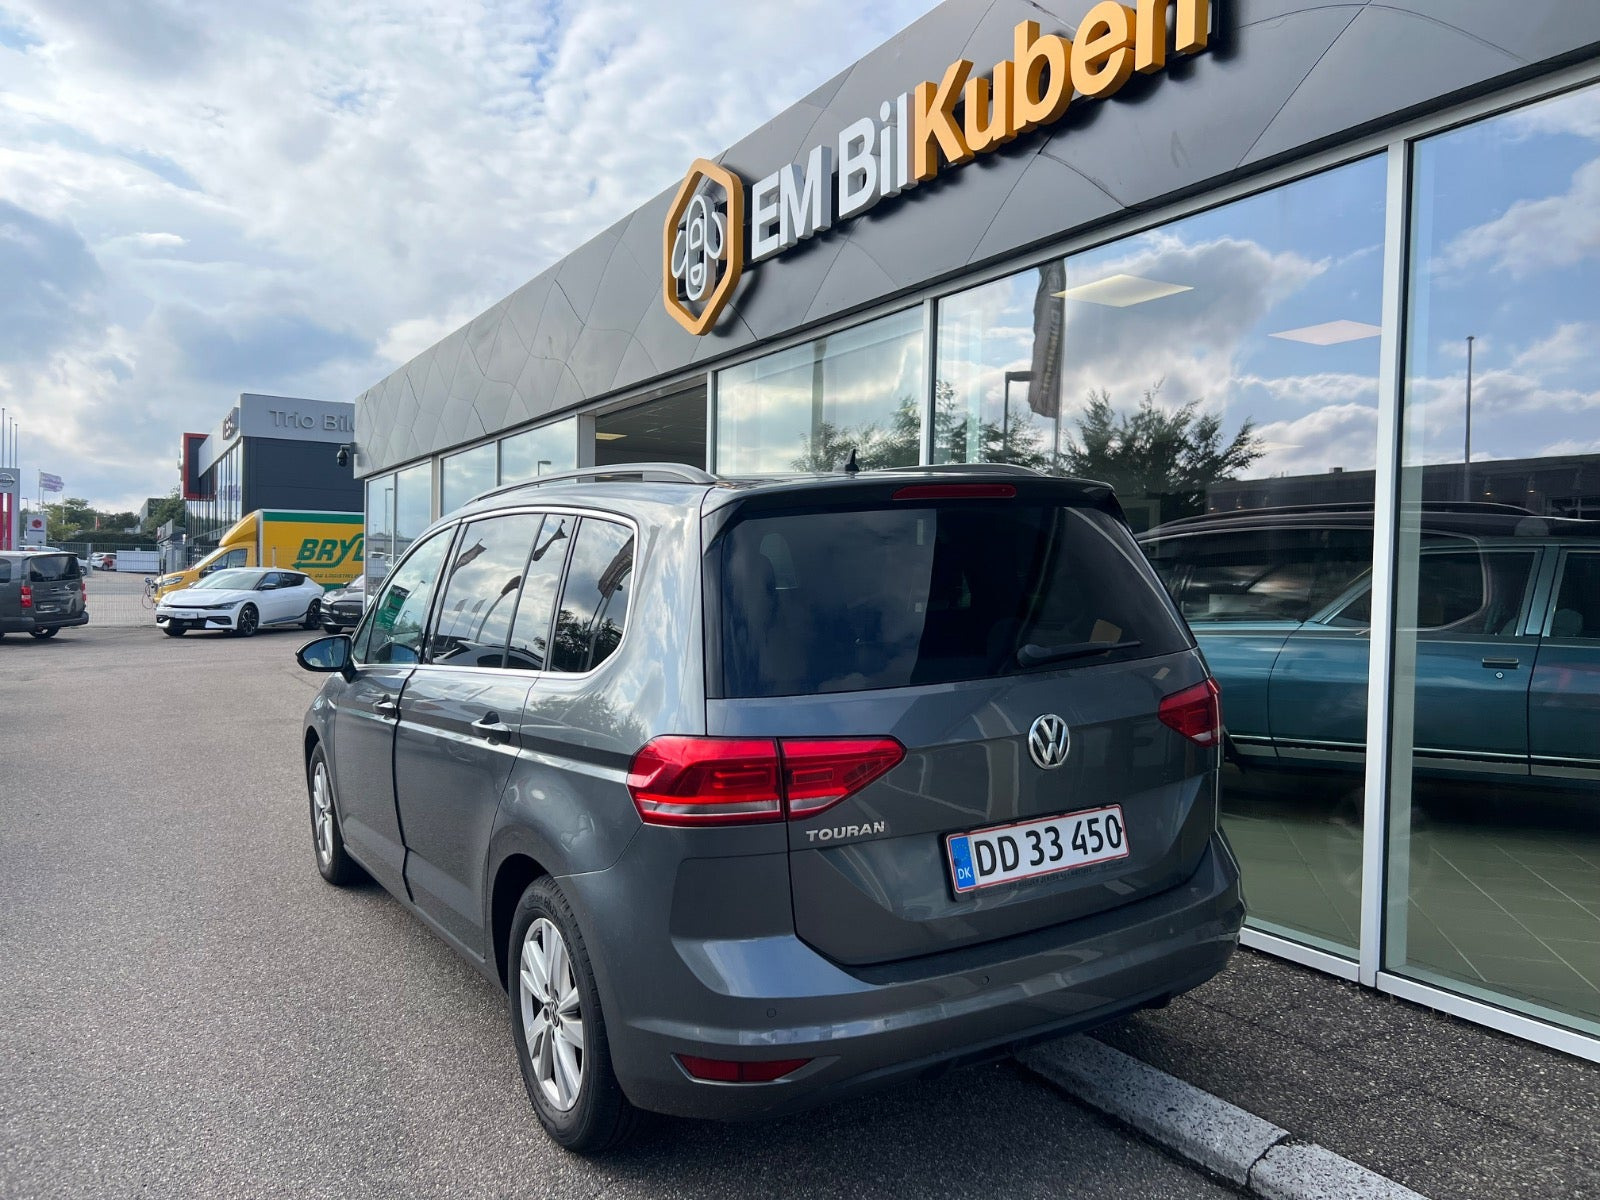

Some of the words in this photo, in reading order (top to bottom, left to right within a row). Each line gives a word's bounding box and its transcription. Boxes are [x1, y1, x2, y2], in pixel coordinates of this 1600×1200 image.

[751, 145, 831, 262] EM
[269, 409, 315, 429] Trio
[323, 414, 355, 432] Bil
[806, 821, 886, 842] TOURAN
[974, 835, 1020, 877] DD
[1025, 826, 1064, 867] 33
[1071, 814, 1123, 856] 450
[957, 866, 971, 880] DK
